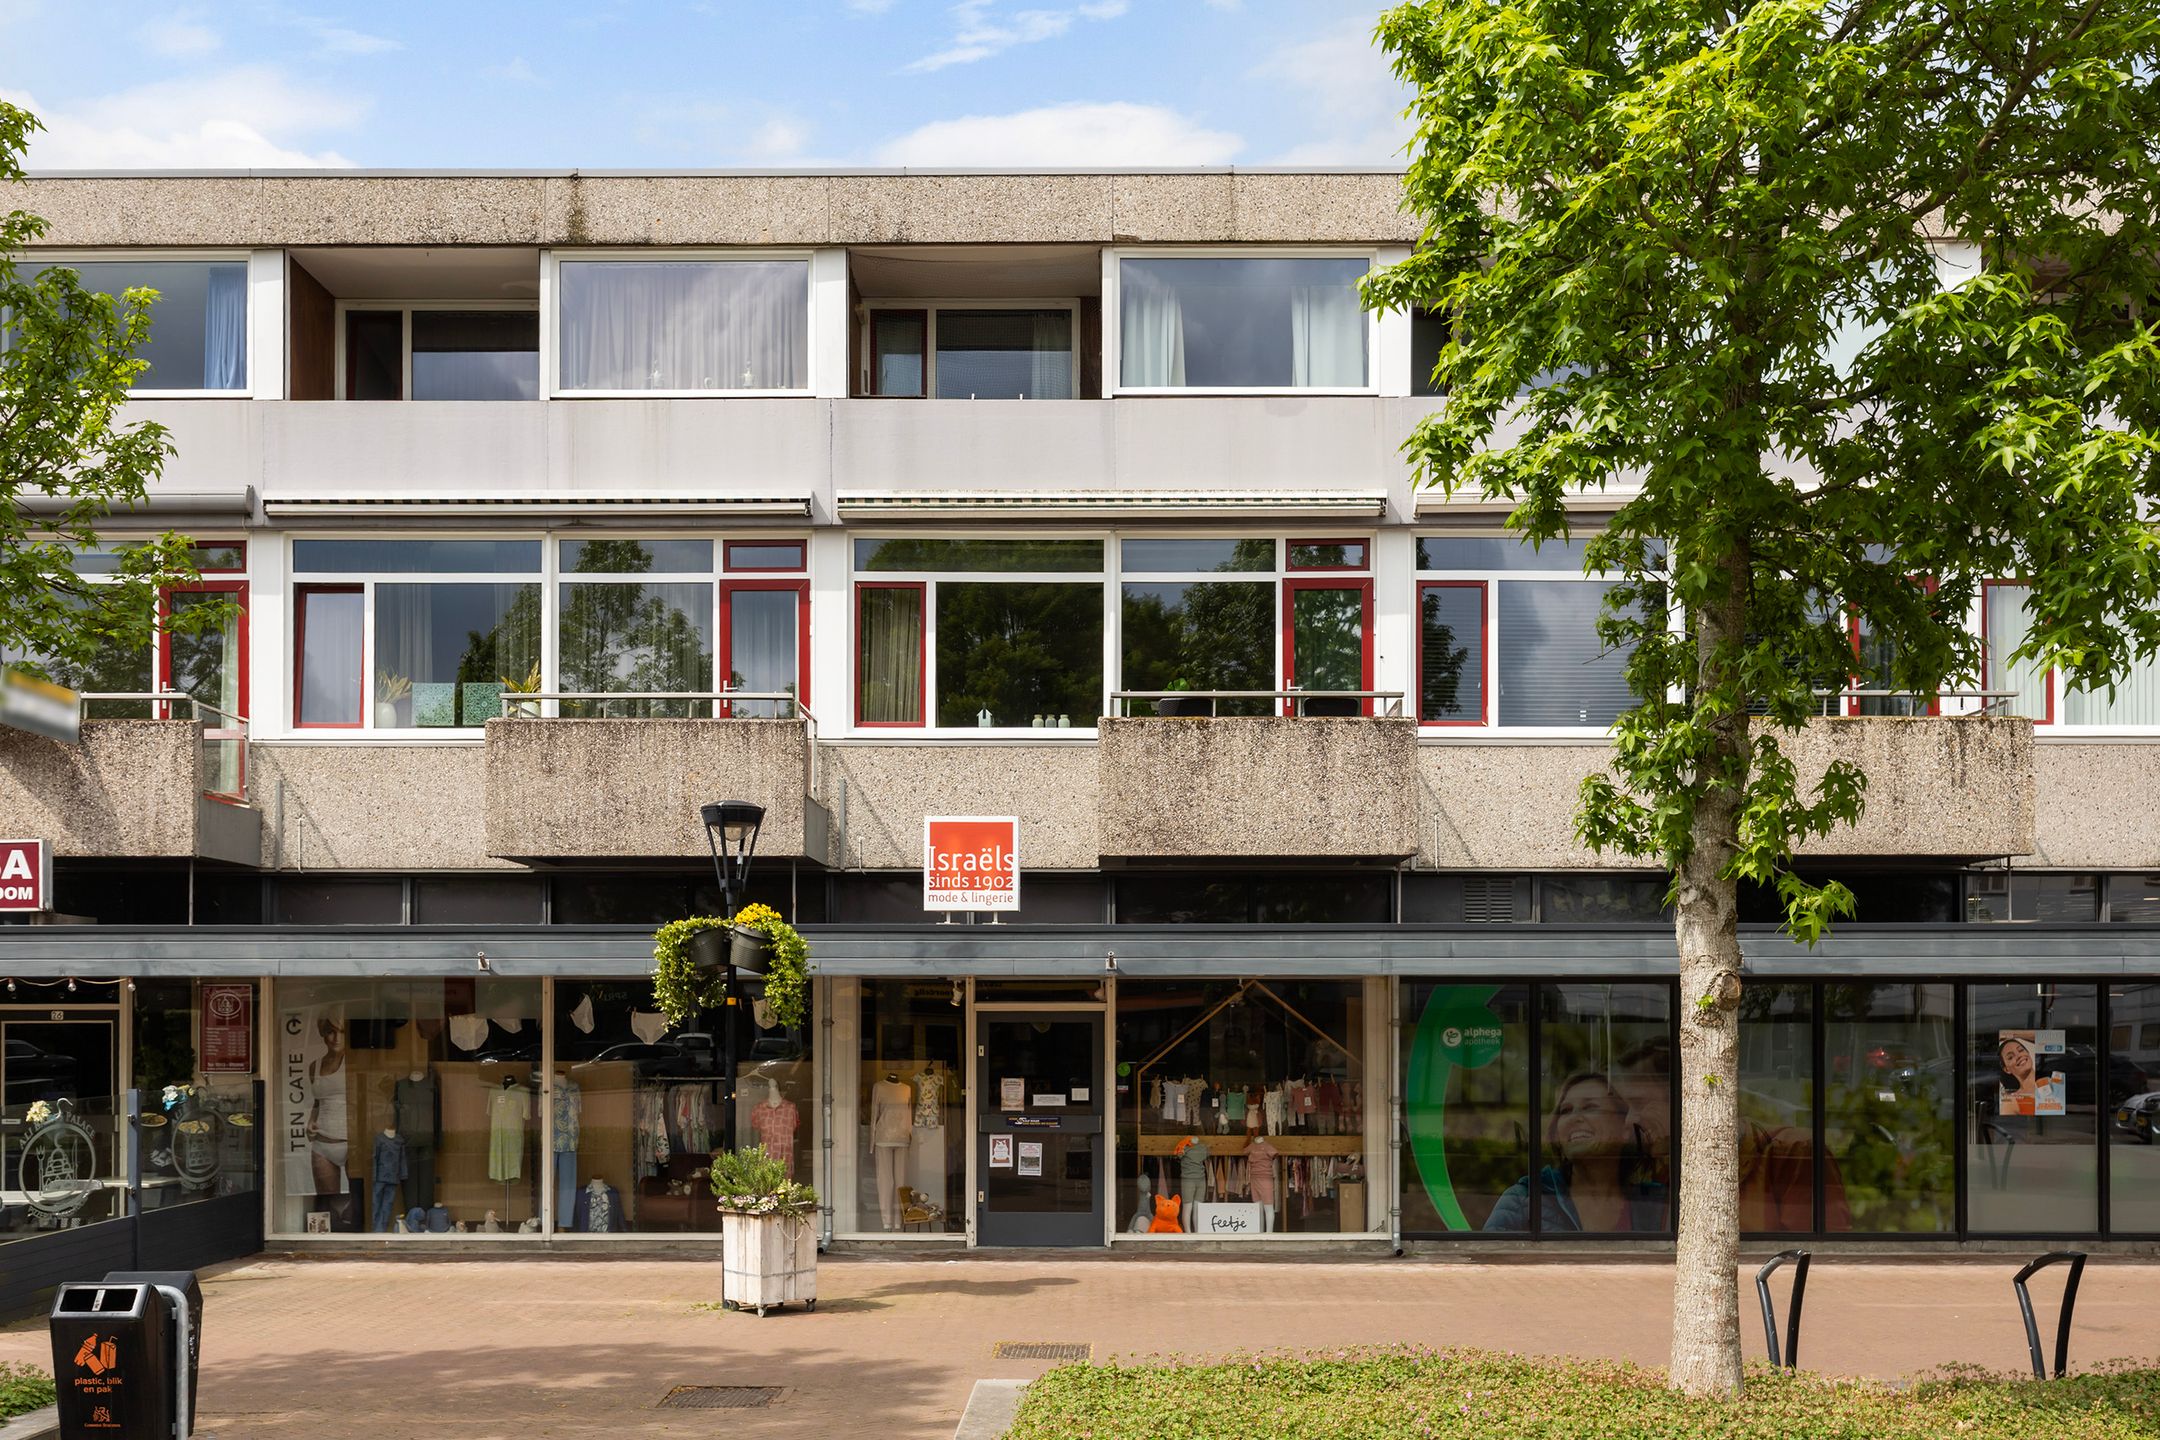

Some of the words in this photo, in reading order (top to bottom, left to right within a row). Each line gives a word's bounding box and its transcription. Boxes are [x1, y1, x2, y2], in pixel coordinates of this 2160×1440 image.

[0, 849, 33, 880] A
[928, 845, 1014, 872] Israëls
[928, 872, 969, 888] sinds
[974, 876, 1014, 891] 1902
[0, 886, 33, 901] OM
[928, 891, 958, 903] mode
[961, 892, 968, 903] &
[971, 891, 1014, 906] lingerie
[1464, 1027, 1502, 1037] alphega
[1464, 1037, 1501, 1046] apotheek
[289, 1053, 305, 1105] CATE
[66, 1111, 96, 1140] PALACE
[290, 1112, 306, 1152] TEN
[1211, 1215, 1247, 1233] feetje
[74, 1378, 105, 1386] plastic,
[96, 1386, 112, 1394] pak
